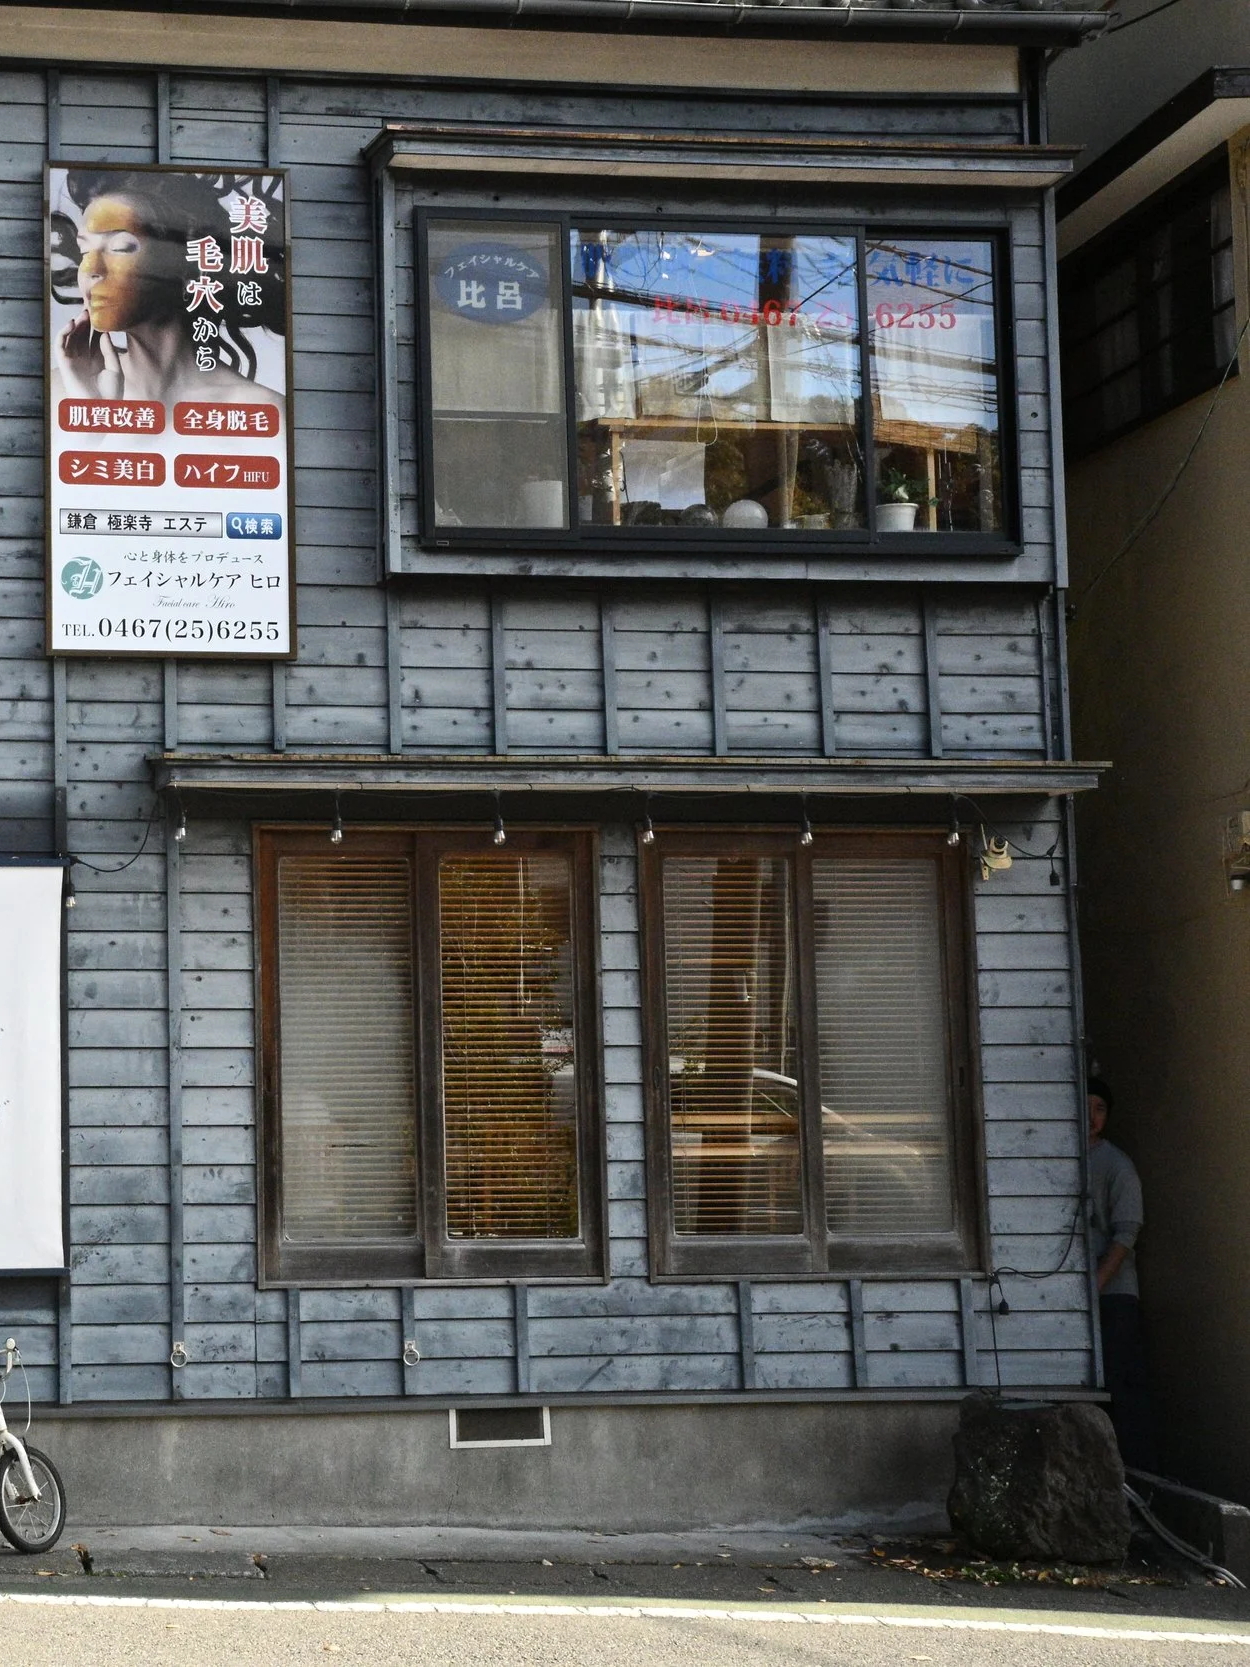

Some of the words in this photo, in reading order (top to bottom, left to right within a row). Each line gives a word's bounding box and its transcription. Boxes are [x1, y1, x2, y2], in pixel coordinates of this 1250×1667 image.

[229, 196, 268, 306] 美肌は
[444, 254, 540, 279] フェイシャルケア
[186, 235, 224, 372] 毛穴から
[456, 280, 523, 310] 比呂
[68, 405, 156, 429] 肌質改善
[183, 408, 269, 432] 全身脱毛
[70, 458, 154, 481] シミ美白
[184, 462, 241, 483] ハイフ
[243, 471, 270, 483] HIFU
[67, 512, 98, 531] 鎌倉
[107, 514, 153, 531] 極楽寺
[163, 516, 208, 533] エステ
[244, 518, 274, 535] 検索
[123, 549, 264, 564] 心と身体をプロデュース
[107, 570, 242, 590] フェイシャルケア
[250, 572, 281, 590] ヒロ
[61, 623, 95, 638] TEL.
[98, 617, 280, 643] 0467(25)6255
